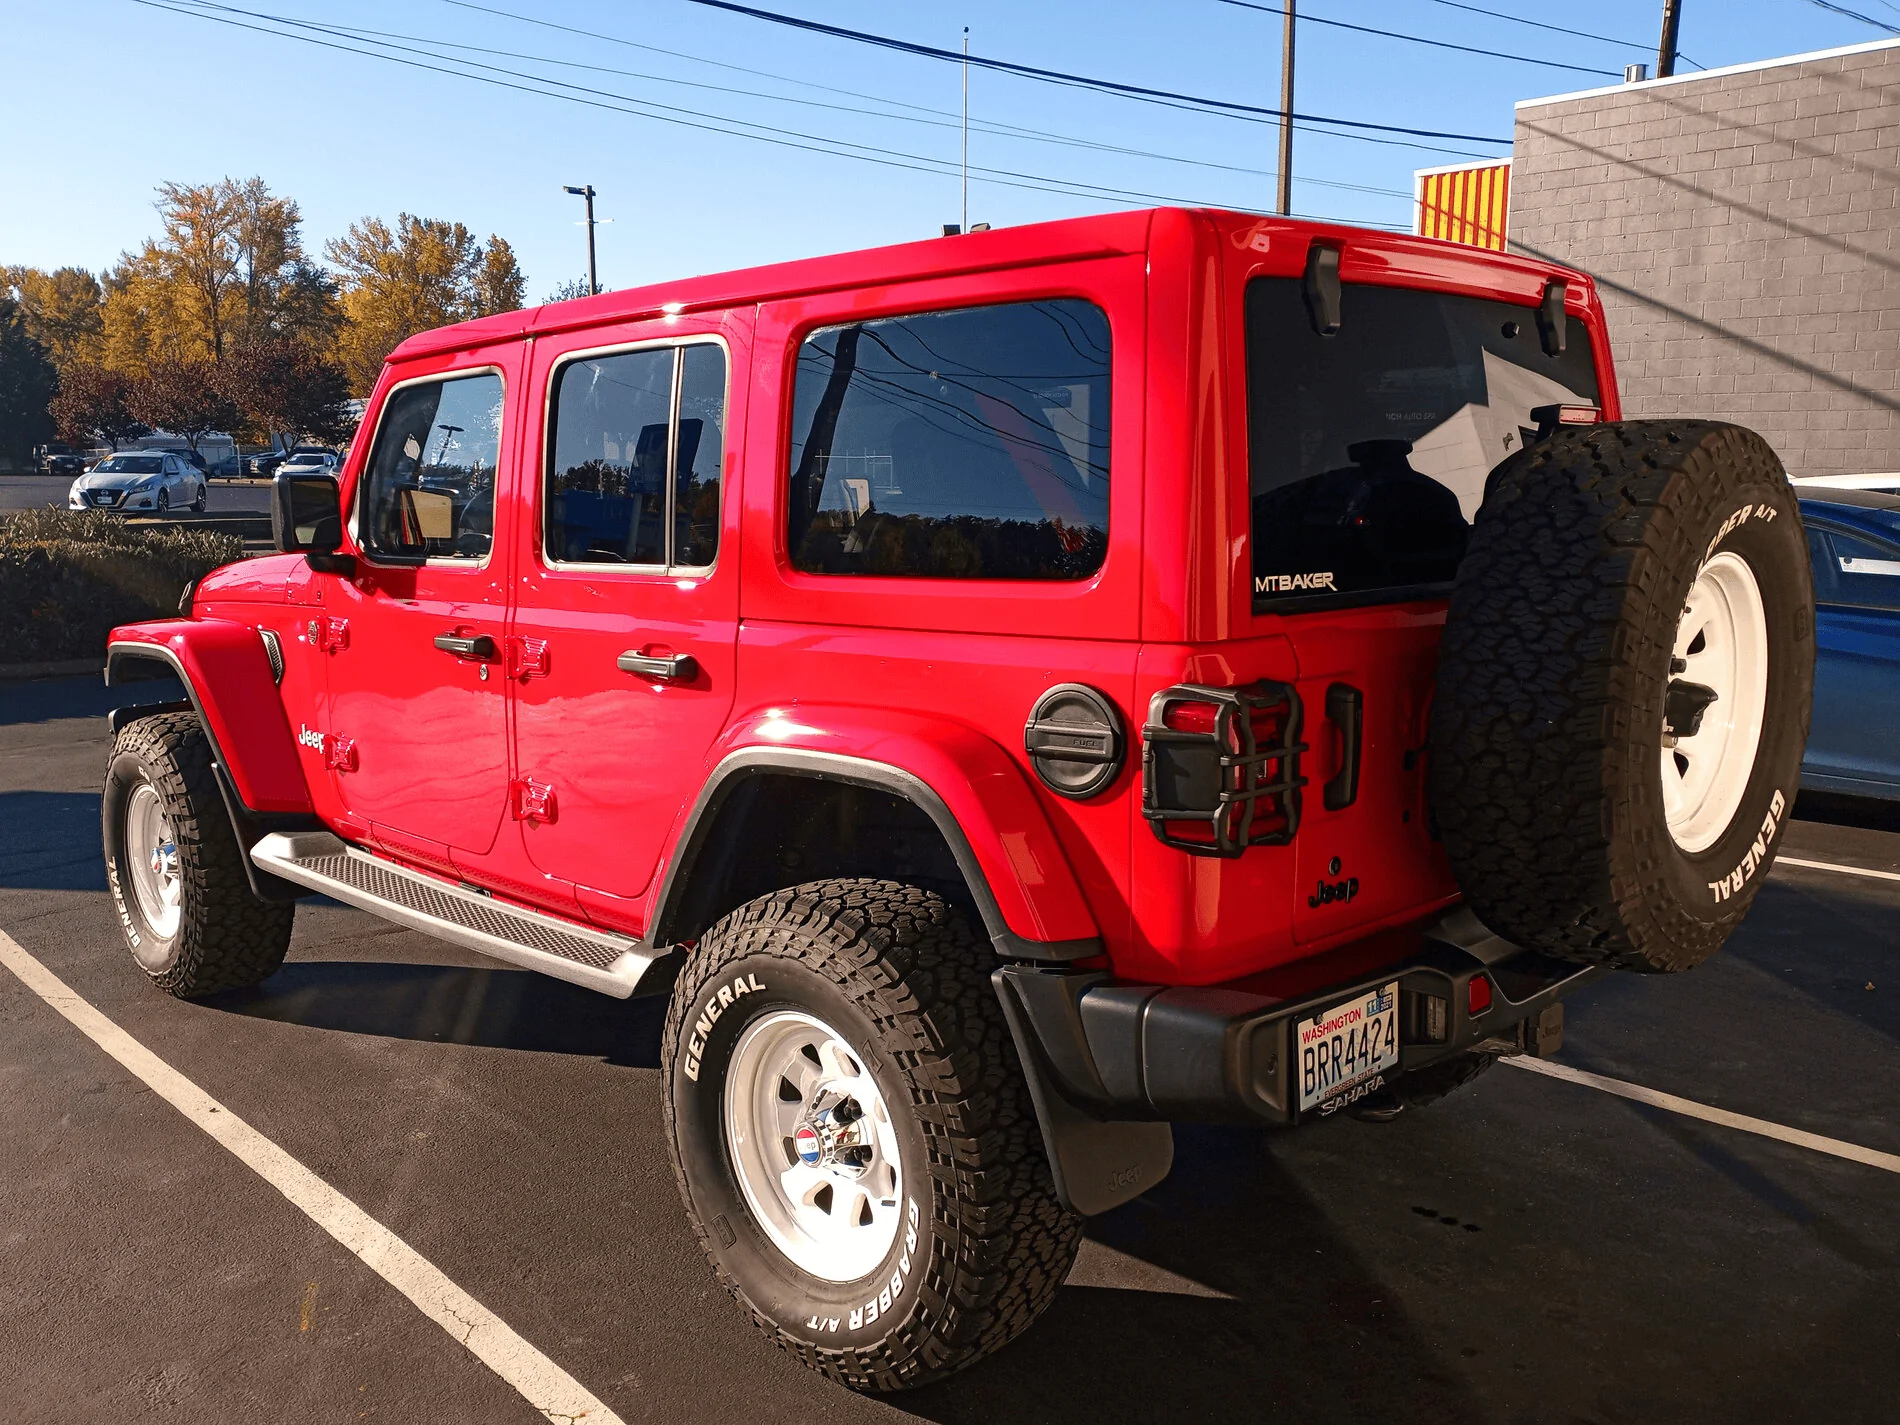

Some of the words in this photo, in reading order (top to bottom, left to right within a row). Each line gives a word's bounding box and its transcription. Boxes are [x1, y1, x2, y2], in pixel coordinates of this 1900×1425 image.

[1754, 503, 1777, 522] A/T
[1708, 789, 1786, 903] GENERAL
[108, 855, 140, 948] GENERAL
[1308, 877, 1359, 908] Jeep
[684, 973, 766, 1082] GENERAL
[1302, 1007, 1361, 1045] WASHINGTON
[1303, 1011, 1395, 1097] BRR4424
[1317, 1075, 1386, 1117] SAHARA
[1324, 1076, 1357, 1099] EVERGREEN
[1357, 1067, 1375, 1083] STATE
[1108, 1164, 1143, 1192] Jeep
[849, 1197, 920, 1331] GRABBER
[807, 1315, 841, 1333] A/T
